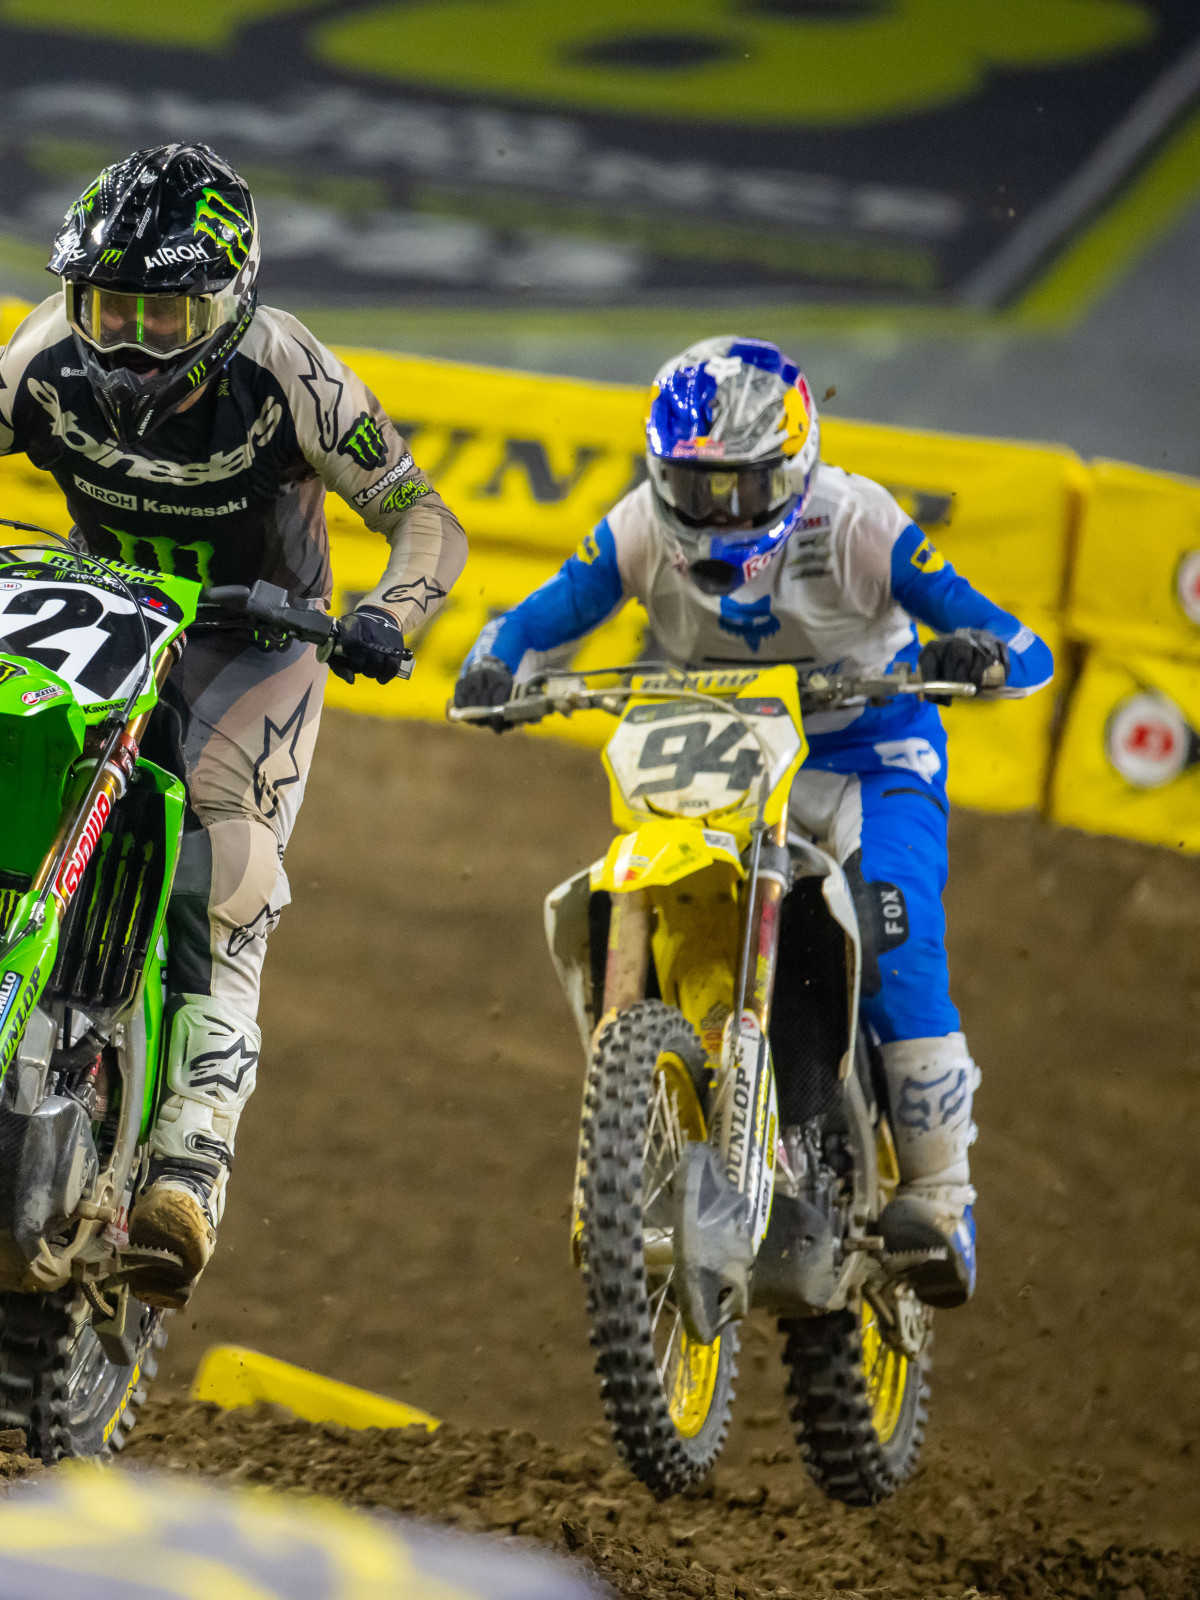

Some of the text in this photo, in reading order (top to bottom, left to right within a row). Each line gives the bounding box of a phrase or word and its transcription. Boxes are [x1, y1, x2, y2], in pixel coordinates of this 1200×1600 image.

[144, 242, 209, 269] AIROH
[204, 281, 226, 292] AIROH
[137, 408, 154, 437] AIROH
[76, 480, 249, 518] AIROH Kawasaki
[354, 453, 414, 507] Kawasaki
[383, 479, 417, 512] TEAM
[82, 699, 137, 715] Kawasa
[630, 720, 766, 798] 94
[62, 790, 111, 898] SHOWA
[880, 889, 904, 935] FOX
[725, 1066, 752, 1188] DUNLOP
